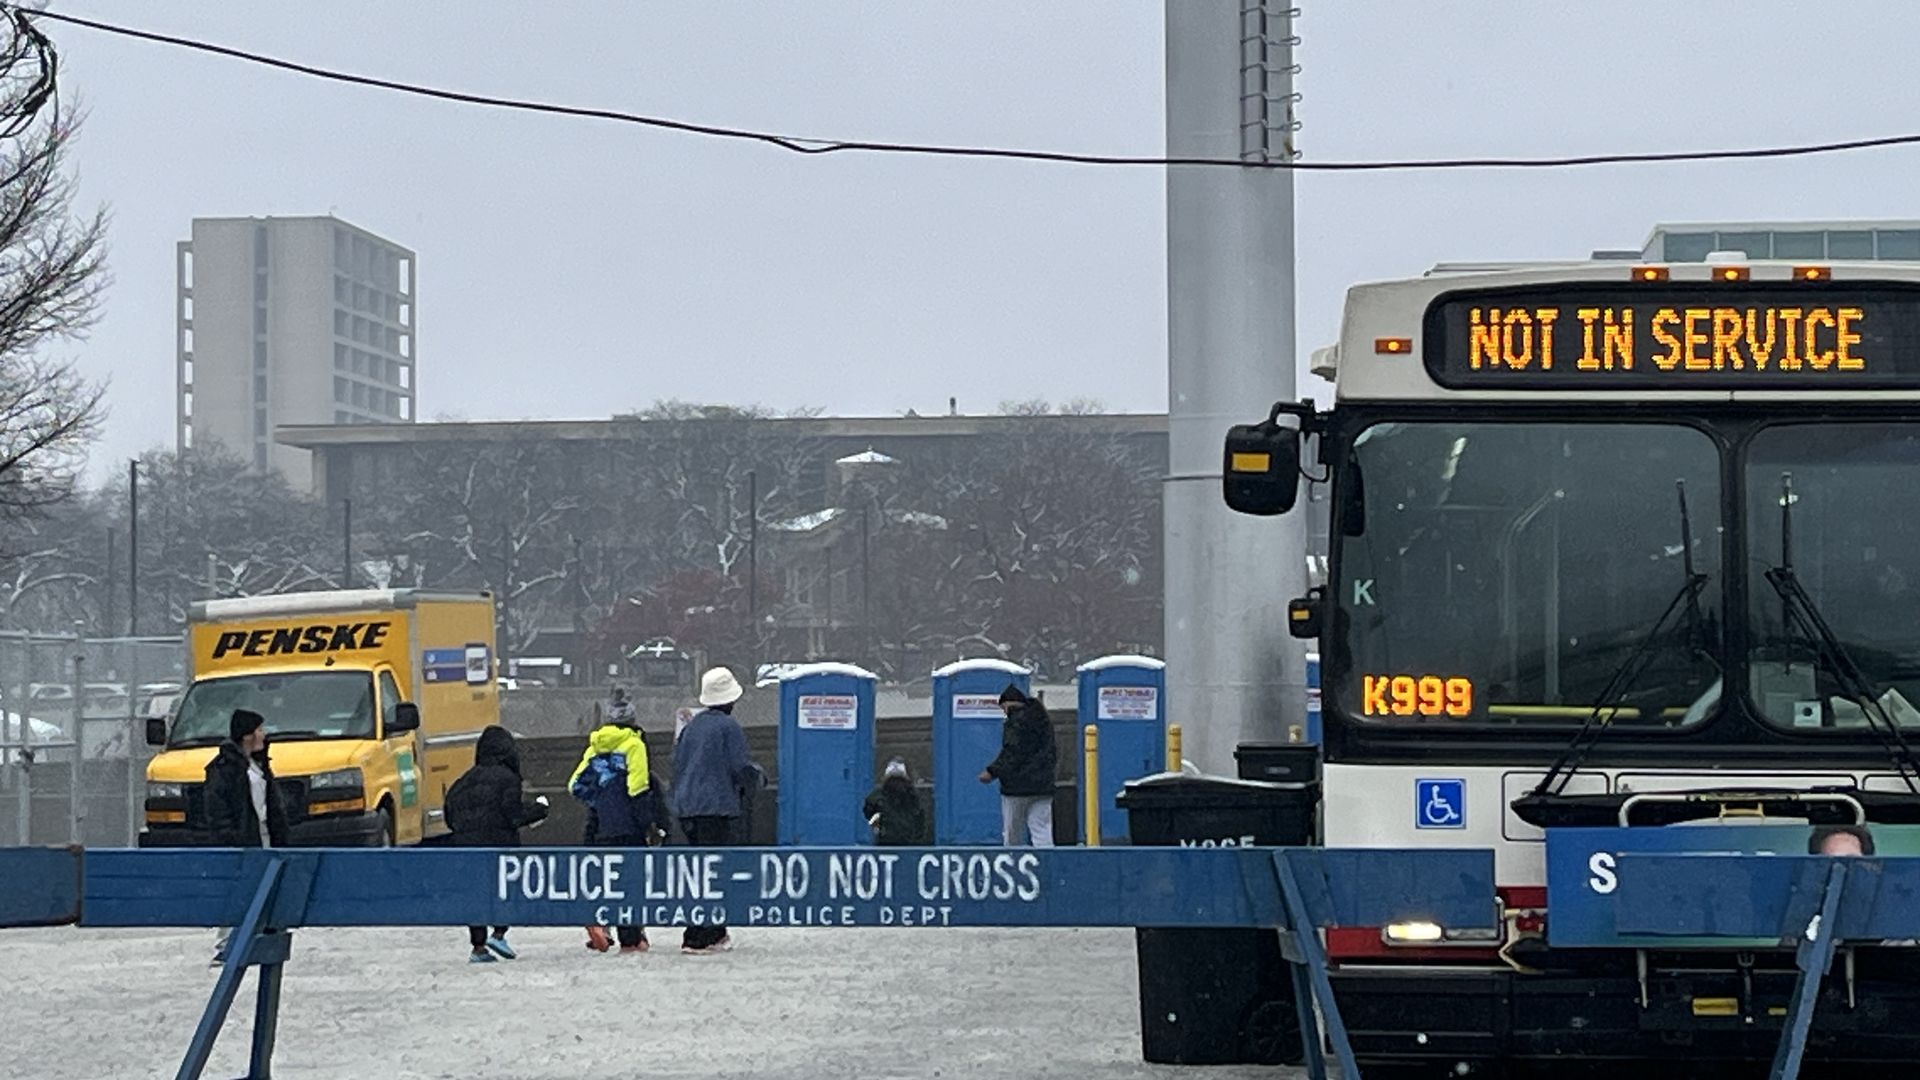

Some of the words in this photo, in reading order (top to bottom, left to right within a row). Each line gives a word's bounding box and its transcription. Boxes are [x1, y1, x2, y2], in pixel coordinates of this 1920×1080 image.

[1468, 307, 1560, 370] NOT
[1576, 307, 1636, 370] IN
[1650, 307, 1866, 370] SERVICE
[1354, 579, 1375, 605] K
[212, 621, 392, 659] PENSKE
[1363, 675, 1473, 716] K999
[498, 854, 625, 900] POLICE
[829, 853, 900, 900] NOT
[917, 853, 1041, 900] CROSS
[595, 905, 727, 925] CHICAGO
[749, 905, 856, 925] POLICE
[879, 906, 953, 925] DEPT
